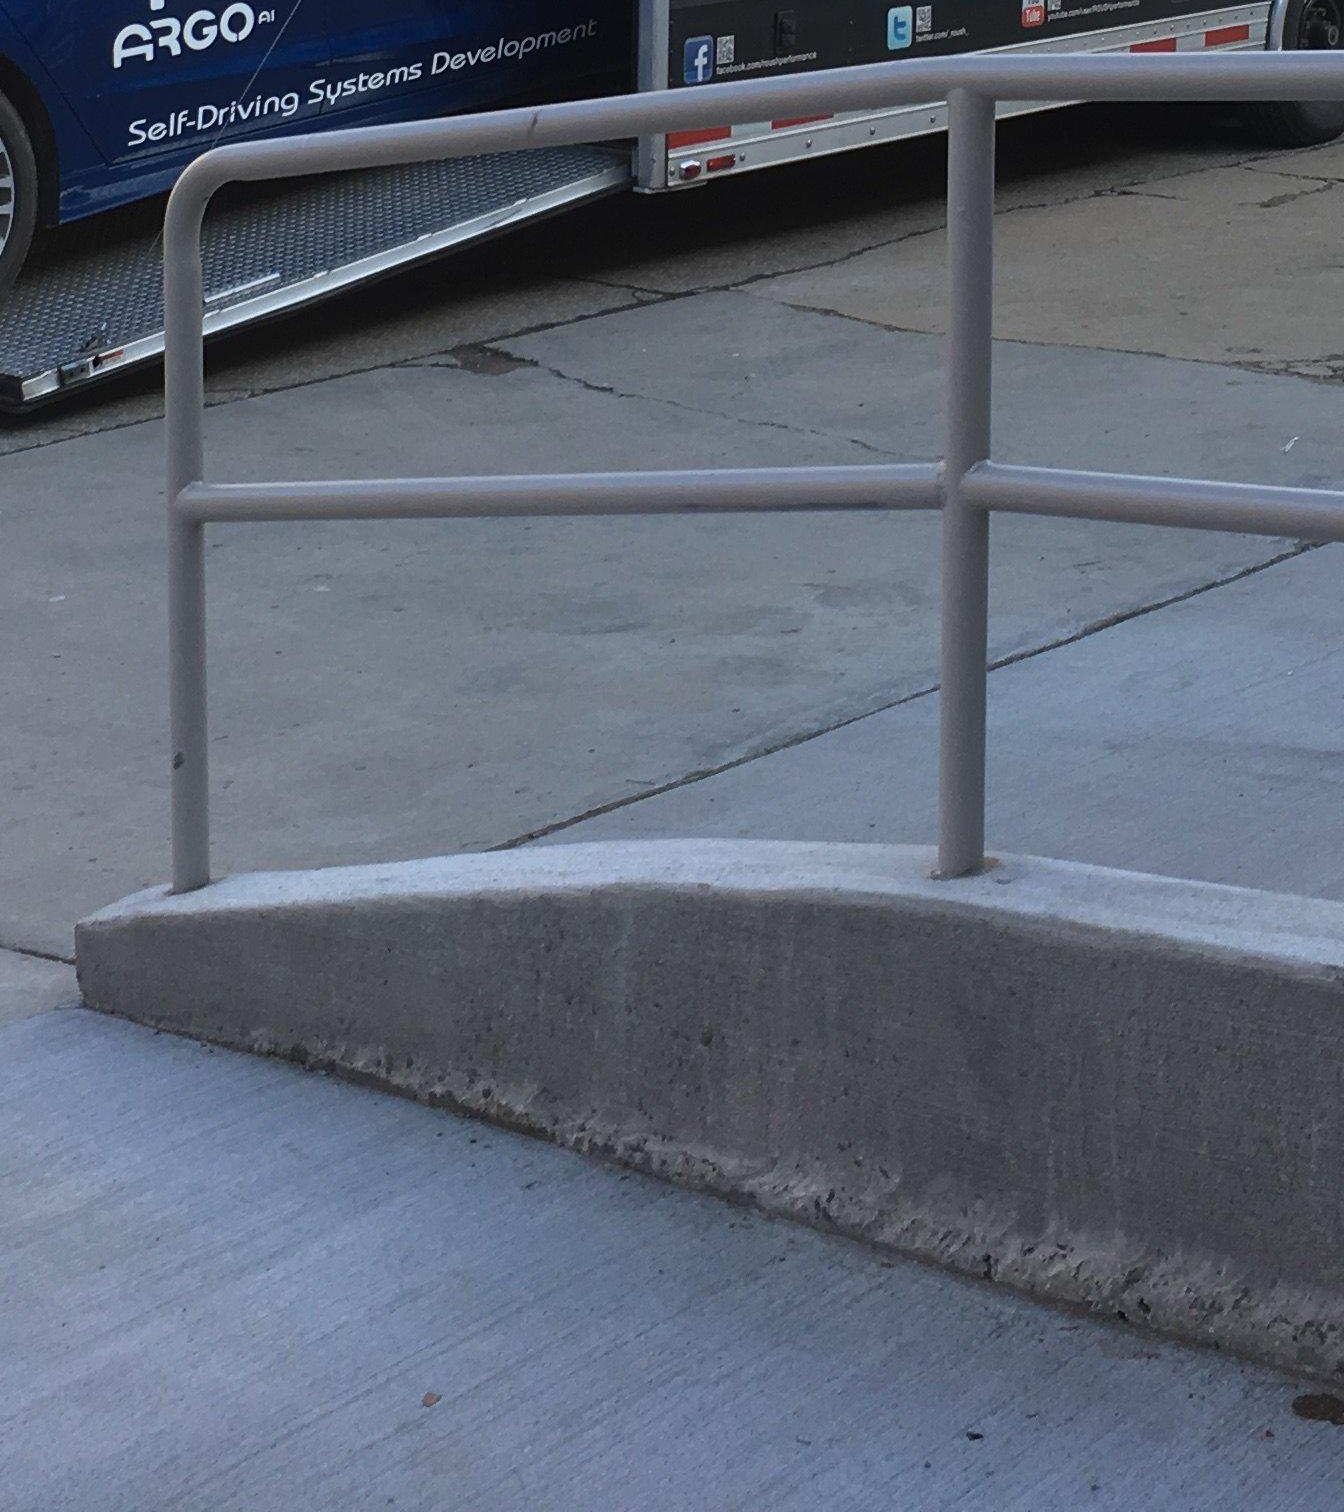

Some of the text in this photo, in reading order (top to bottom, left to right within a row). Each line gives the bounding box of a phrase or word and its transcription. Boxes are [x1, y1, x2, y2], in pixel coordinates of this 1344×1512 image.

[112, 1, 276, 69] ARGO AI
[127, 17, 598, 147] Self-Driving Systems Development
